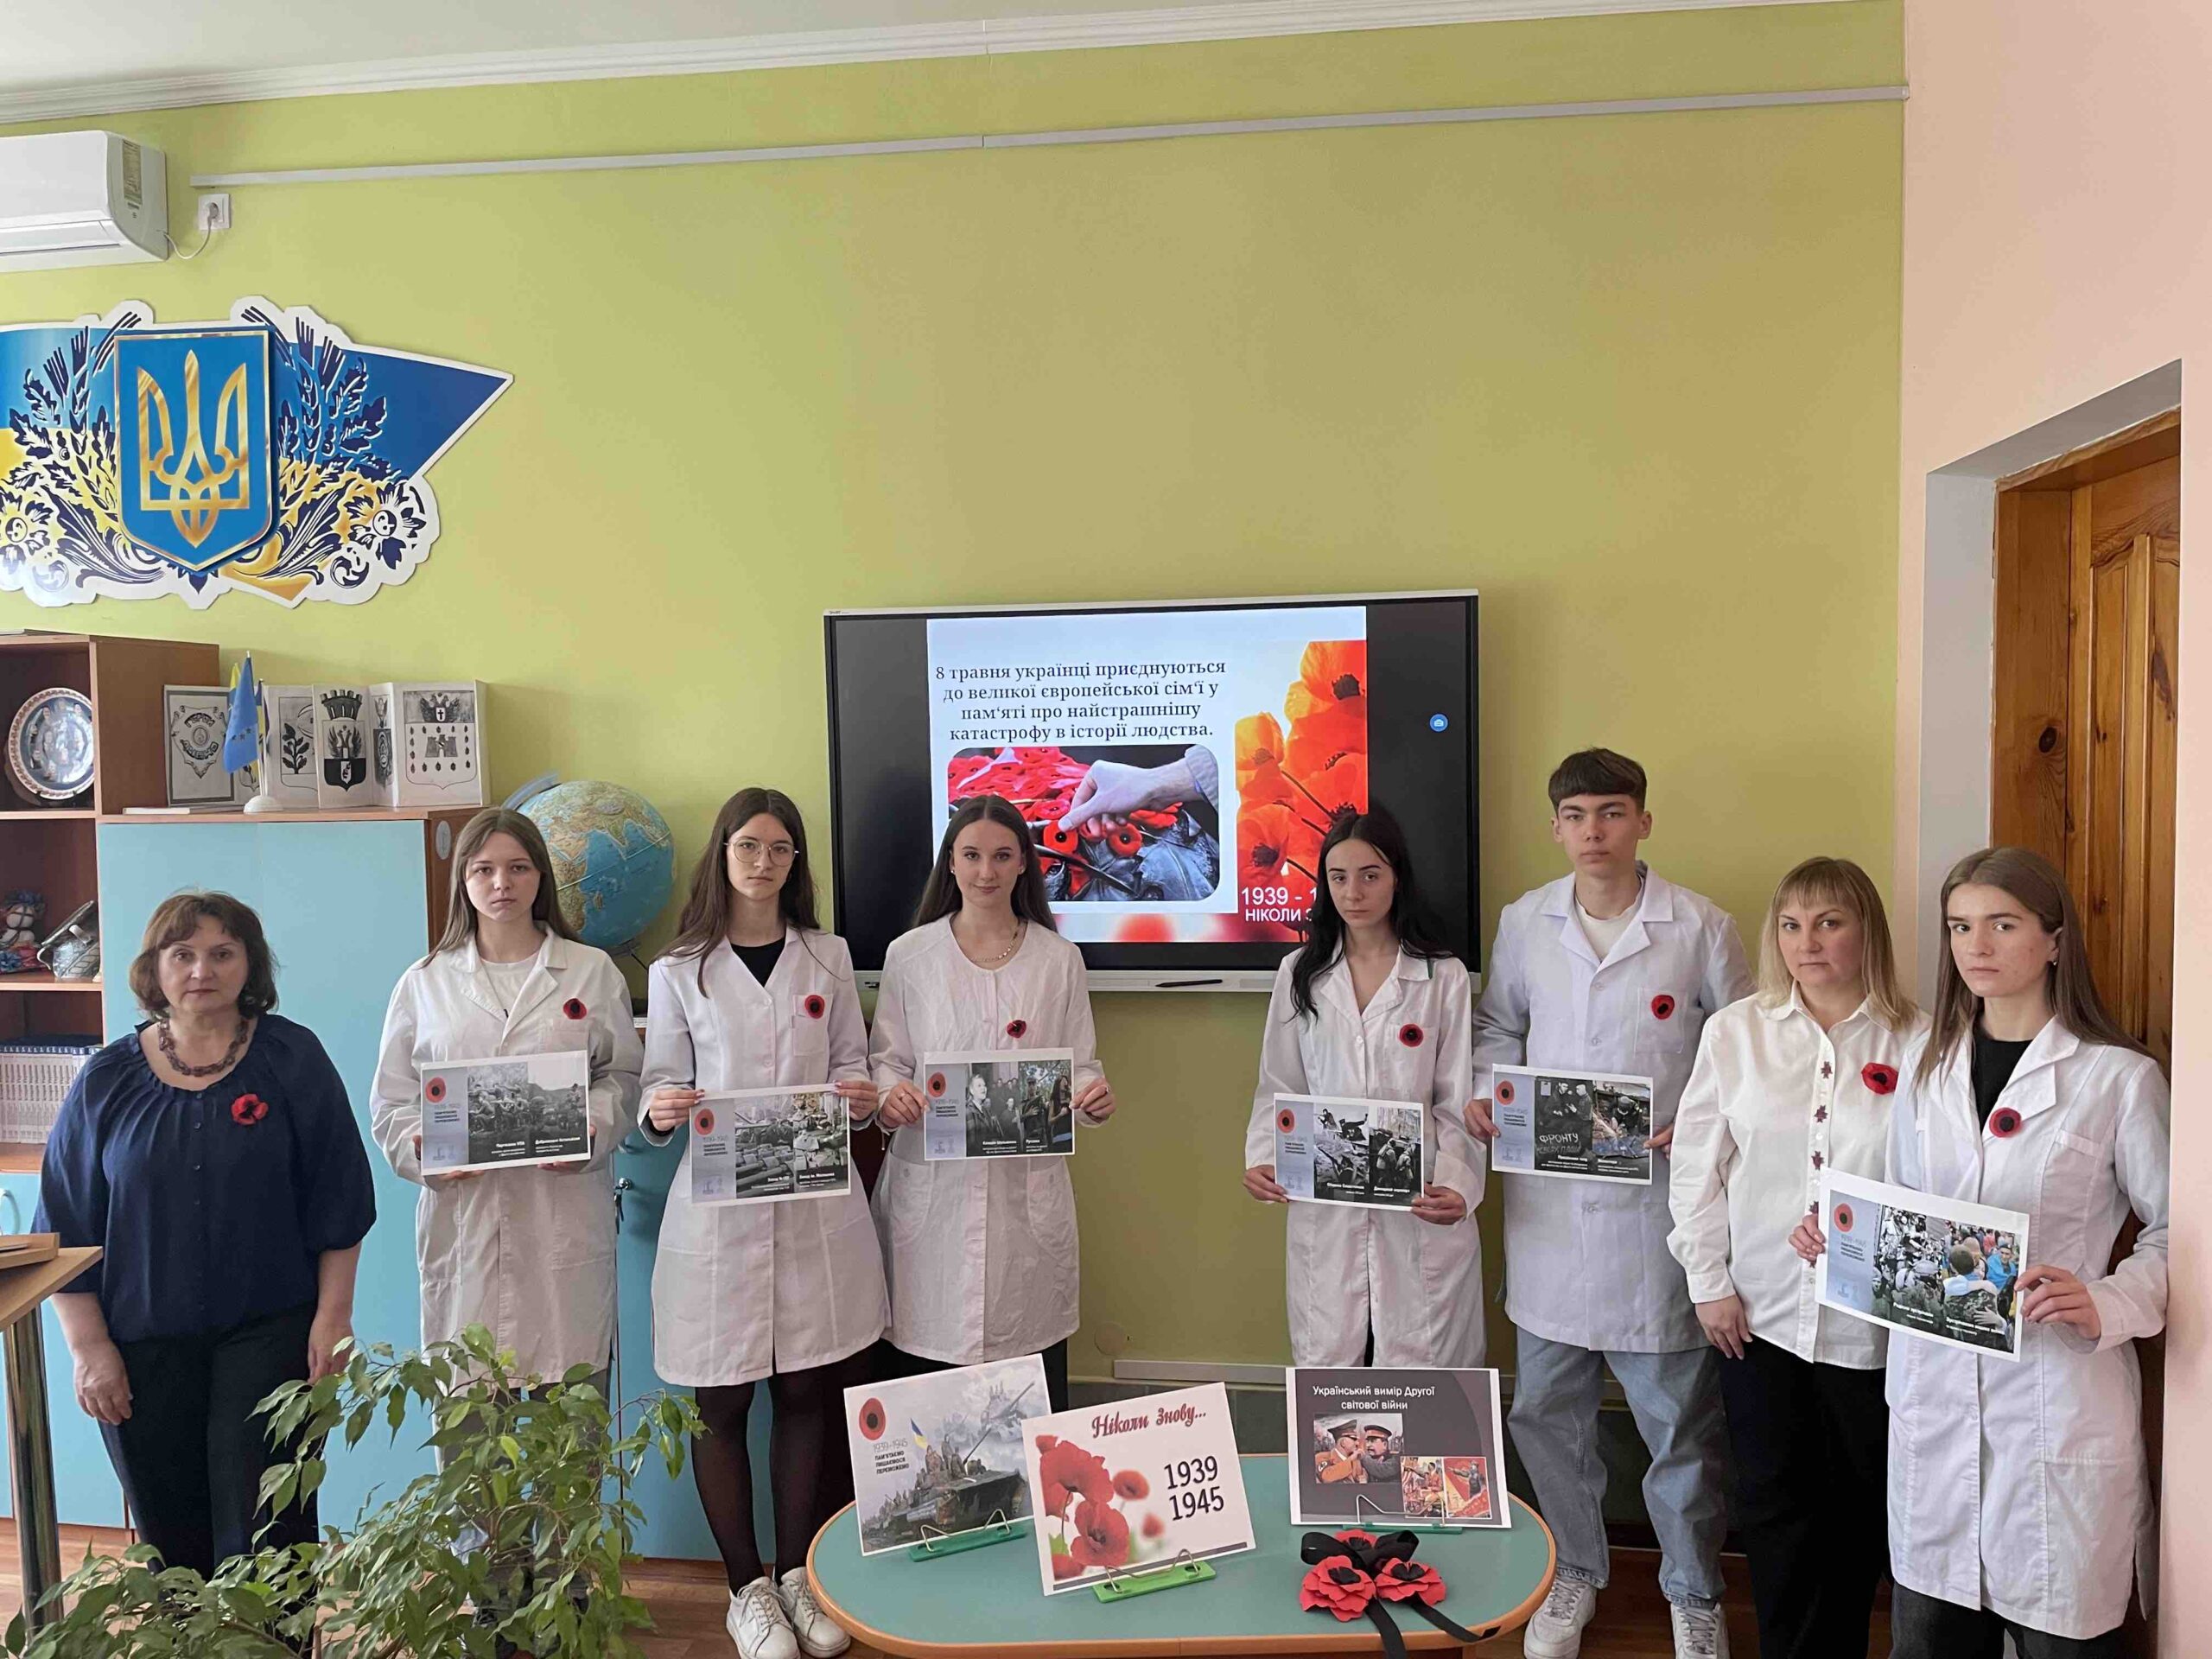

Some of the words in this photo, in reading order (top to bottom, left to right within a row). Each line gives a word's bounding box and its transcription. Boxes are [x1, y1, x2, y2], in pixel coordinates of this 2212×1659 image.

[936, 666, 944, 680] 8
[950, 667, 1011, 683] травня
[1015, 663, 1091, 681] українці
[1095, 660, 1227, 680] приєднуються
[943, 689, 964, 703] до
[968, 684, 1037, 701] великої
[1040, 682, 1159, 702] європейської
[1208, 683, 1219, 698] у
[1030, 706, 1063, 723] про
[1066, 701, 1202, 721] найстрашнішу
[950, 725, 1052, 744] катастрофу
[1056, 728, 1065, 739] в
[1070, 722, 1127, 741] історії
[1130, 723, 1213, 741] людства.
[1241, 887, 1289, 906] 1939
[1245, 907, 1302, 922] НІКОЛИ
[1539, 1132, 1579, 1144] ФРОНТУ
[1313, 1385, 1371, 1397] Український
[1374, 1386, 1402, 1397] вимір
[1404, 1386, 1435, 1398] Другої
[1341, 1400, 1380, 1410] світової
[1381, 1400, 1408, 1410] війни
[1091, 1411, 1150, 1439] Ніколи
[1164, 1455, 1218, 1490] 1939
[1169, 1485, 1224, 1522] 1945
